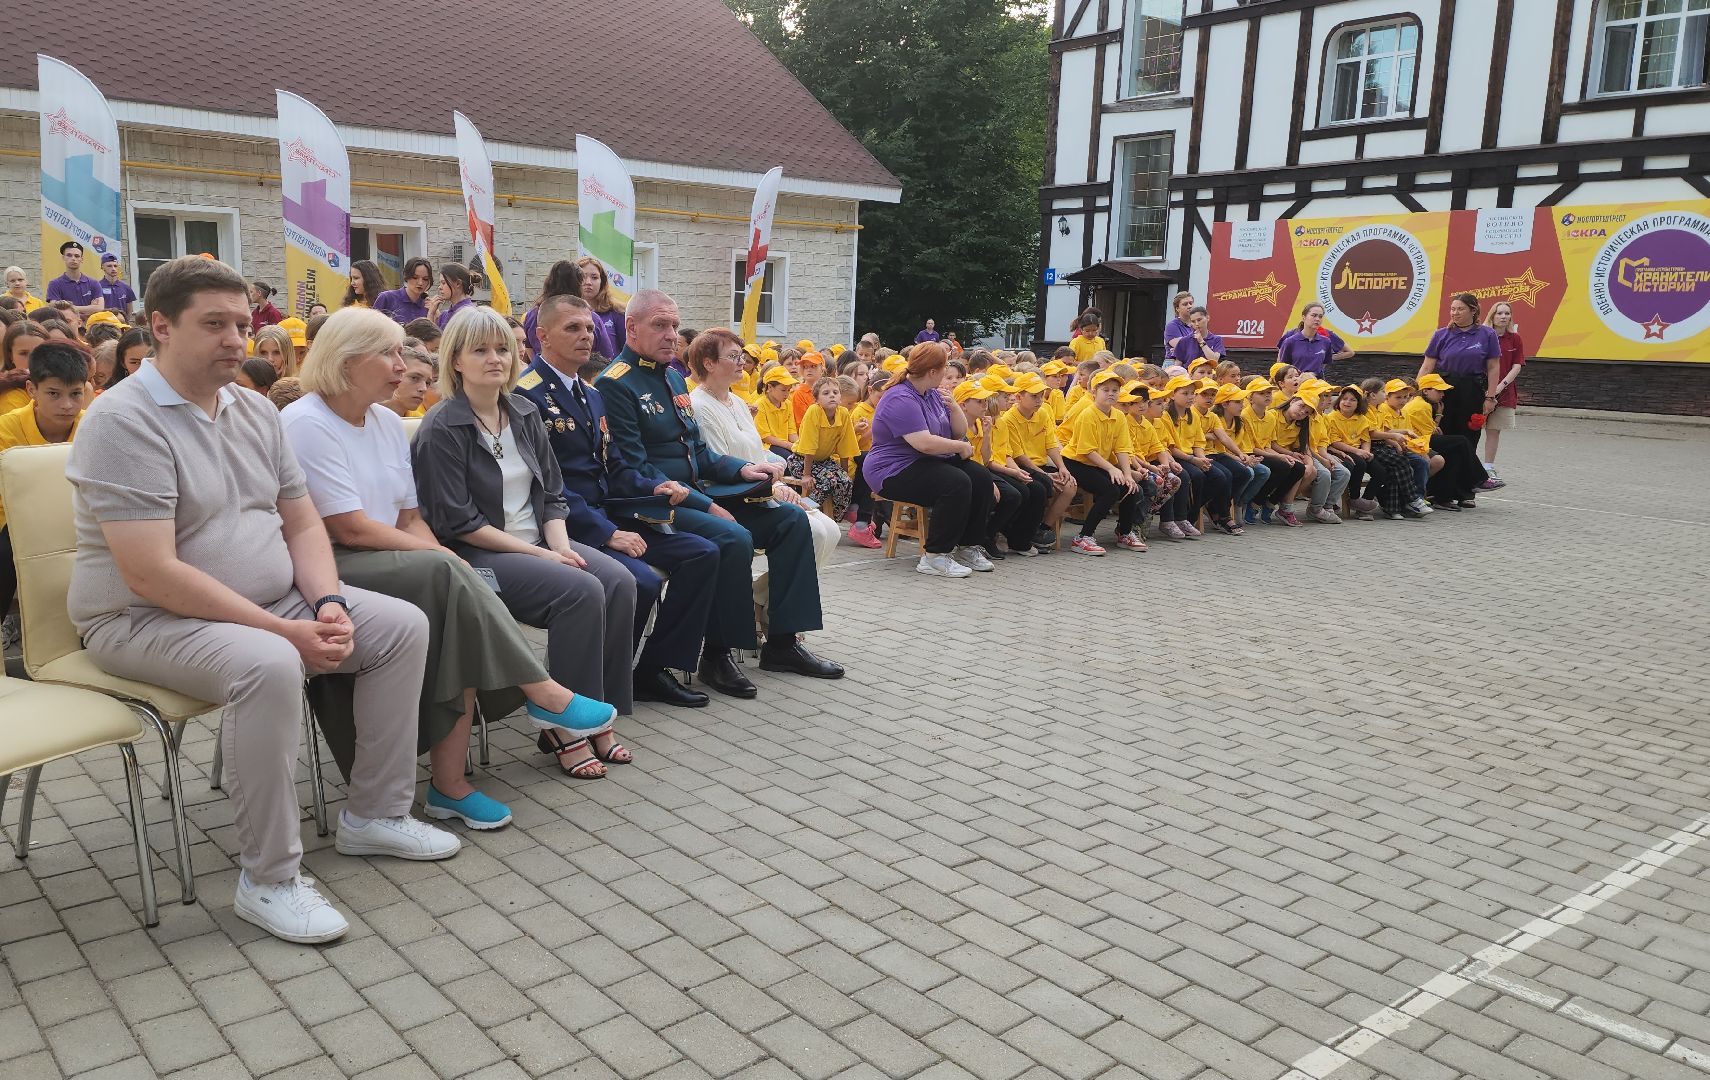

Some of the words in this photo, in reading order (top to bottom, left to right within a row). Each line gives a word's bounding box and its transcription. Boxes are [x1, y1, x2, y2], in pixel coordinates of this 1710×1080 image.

[1363, 228, 1410, 246] ПРОГРАММА
[1634, 271, 1710, 282] ХРАНИТЕЛИ
[1633, 281, 1696, 292] ИСТОРИИ
[1236, 320, 1265, 335] 2024
